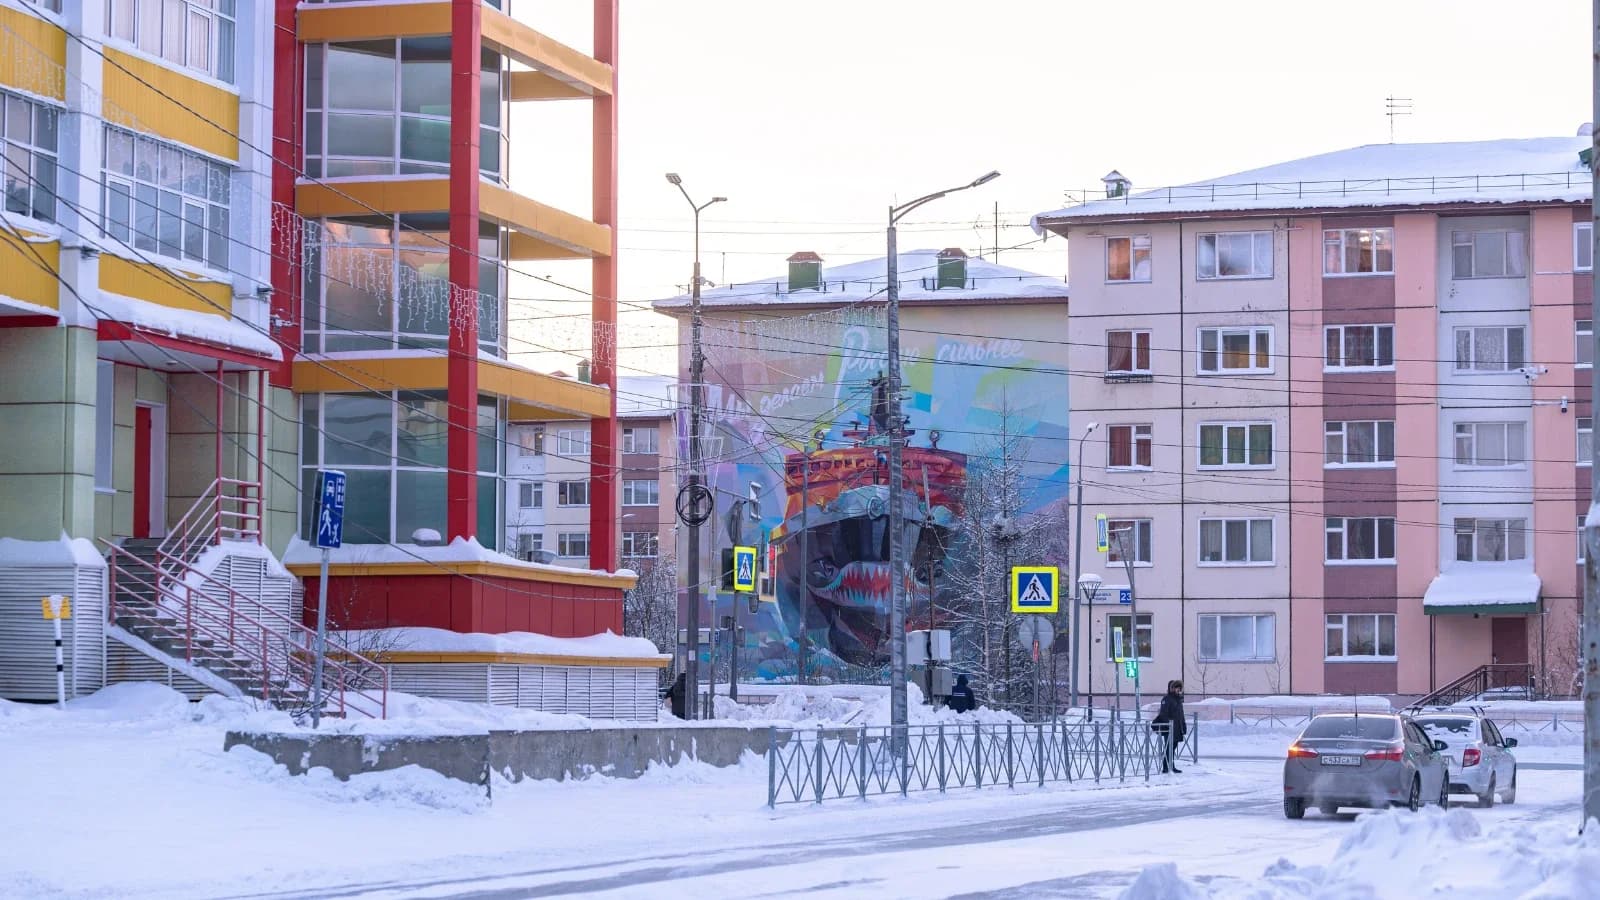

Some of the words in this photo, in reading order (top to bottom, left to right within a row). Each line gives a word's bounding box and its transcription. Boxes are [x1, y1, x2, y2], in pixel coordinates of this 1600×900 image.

[760, 371, 825, 416] делаем
[937, 340, 1023, 361] сильнее
[1120, 592, 1132, 601] 23
